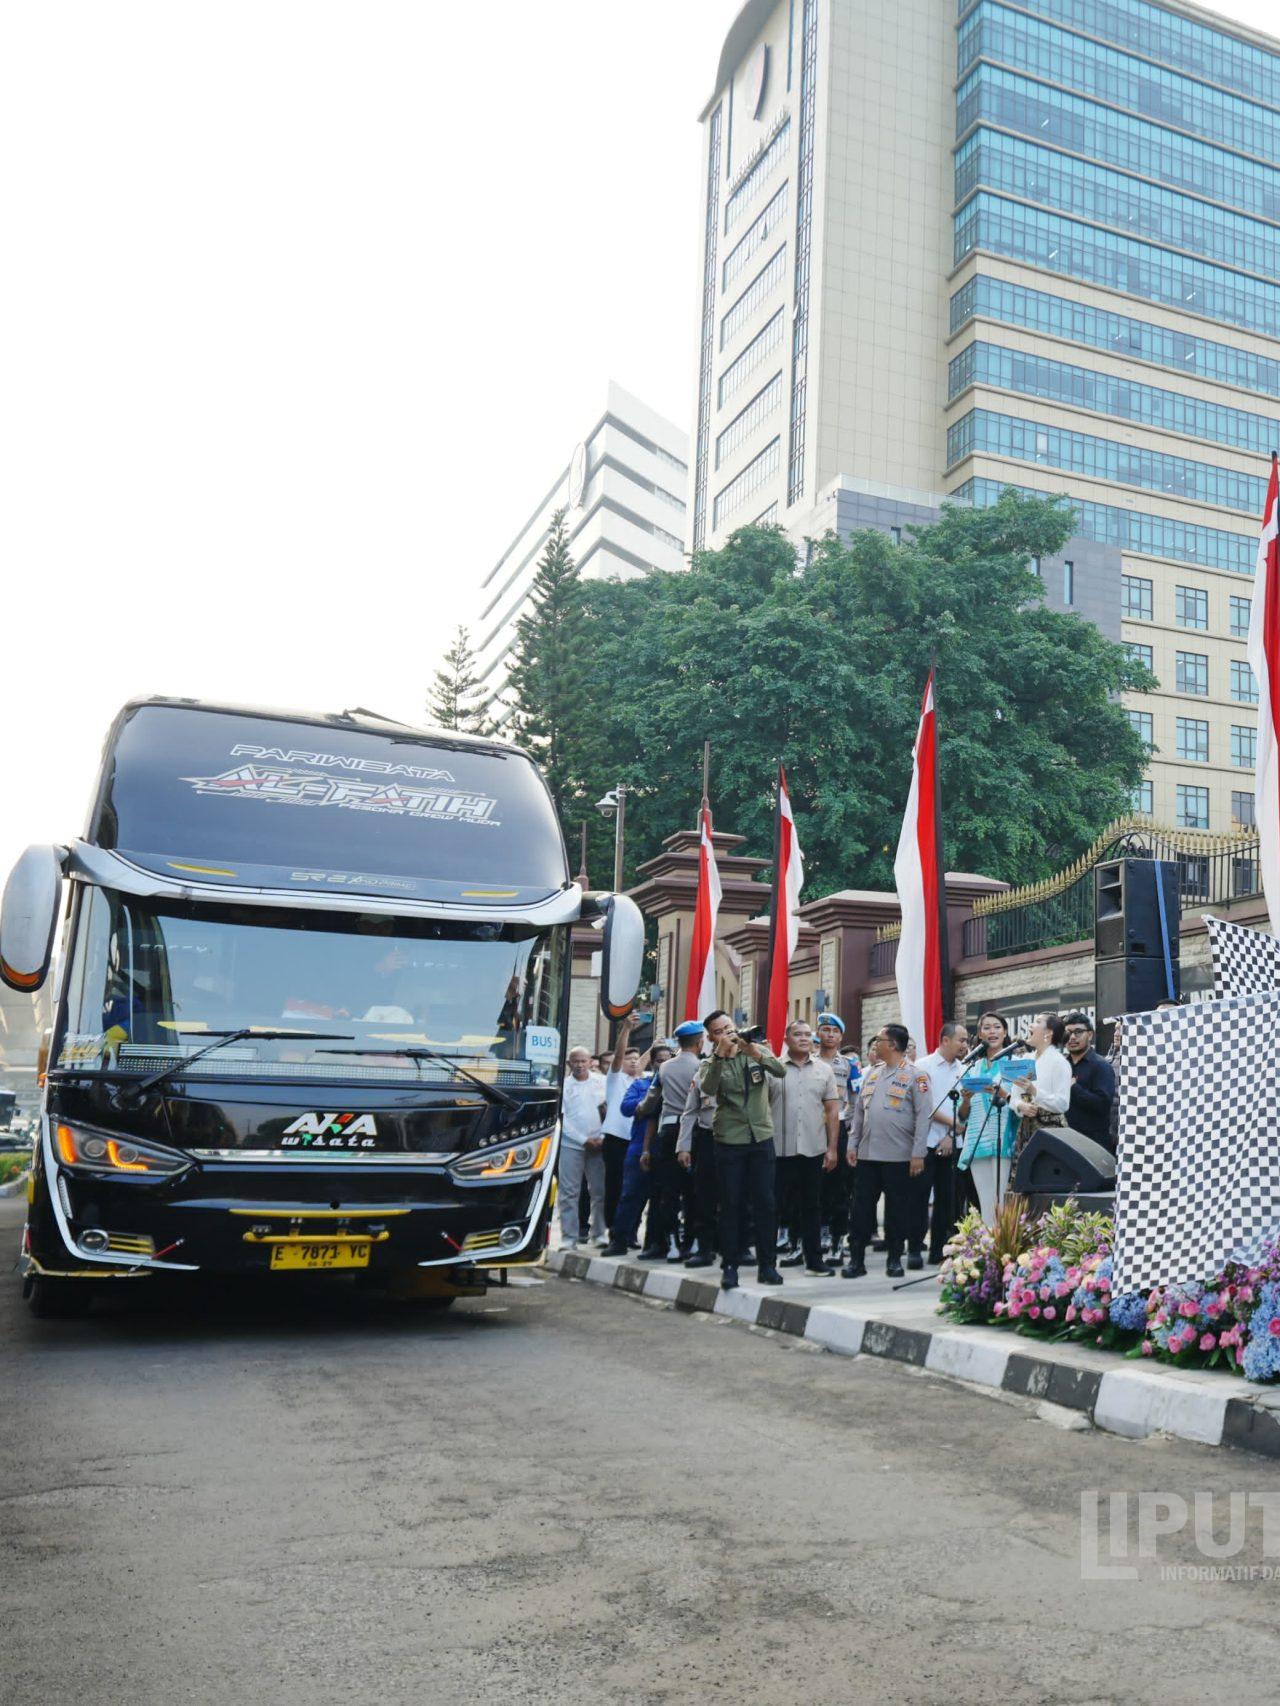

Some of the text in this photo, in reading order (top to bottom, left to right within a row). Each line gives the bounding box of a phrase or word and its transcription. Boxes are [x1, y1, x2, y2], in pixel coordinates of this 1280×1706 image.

[229, 744, 456, 782] PARIWISATA
[409, 811, 454, 821] CREW
[459, 817, 501, 826] MUDA
[531, 1035, 553, 1048] BUS
[275, 1246, 285, 1261] E
[350, 1244, 367, 1259] YC
